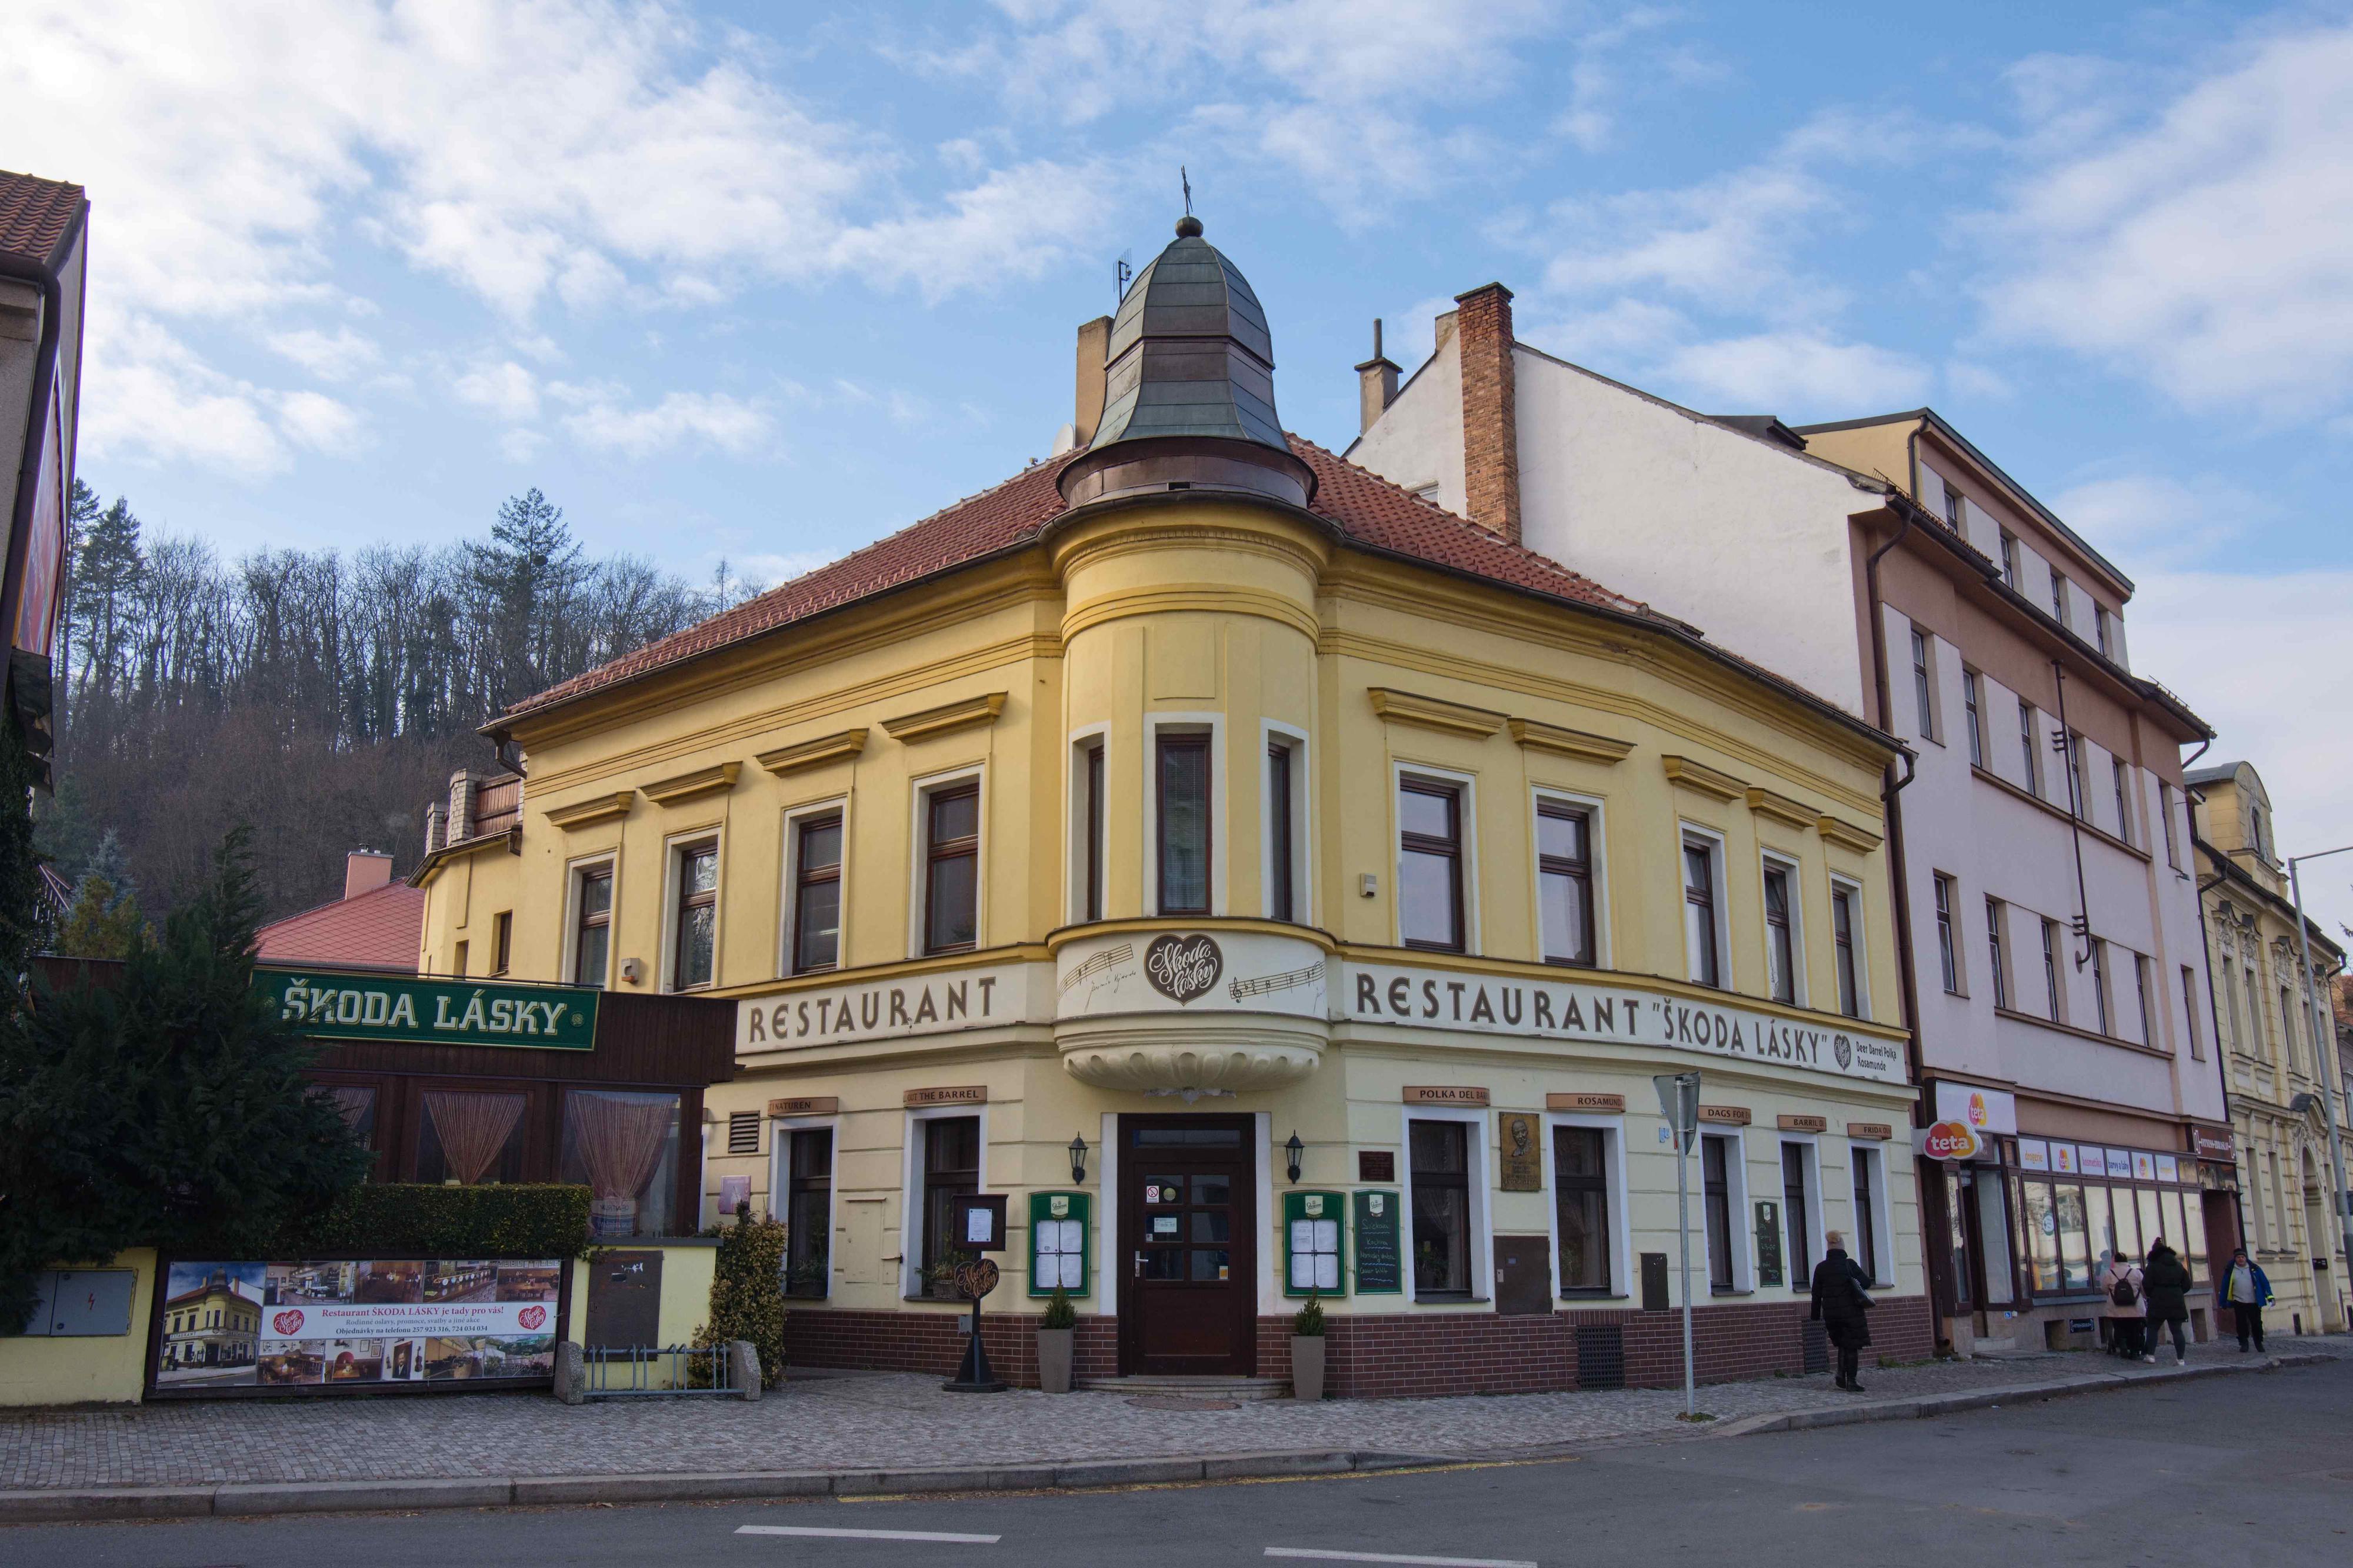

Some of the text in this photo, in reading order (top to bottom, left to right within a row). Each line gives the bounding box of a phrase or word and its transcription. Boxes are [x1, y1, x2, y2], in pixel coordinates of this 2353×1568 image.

[1149, 939, 1211, 984] Škoda
[1167, 957, 1217, 997] lásky
[283, 978, 567, 1035] ŠKODA LÁSKY
[749, 976, 996, 1043] RESTAURANT
[1357, 973, 1639, 1035] RESTAURANT
[1884, 1047, 1897, 1061] Polka
[1857, 1056, 1886, 1071] Rosamunde
[920, 1092, 935, 1100] THE
[939, 1090, 979, 1099] BARREL
[1420, 1090, 1455, 1098] POLKA
[775, 1101, 811, 1110] NATUREN
[1971, 1105, 1985, 1120] teta
[1931, 1136, 1969, 1150] teta
[2082, 1156, 2102, 1167] kosmetika
[372, 1307, 405, 1316] ŠKODA
[408, 1306, 440, 1315] LÁSKY
[441, 1308, 449, 1317] je
[452, 1307, 469, 1316] tady
[472, 1308, 486, 1316] pro
